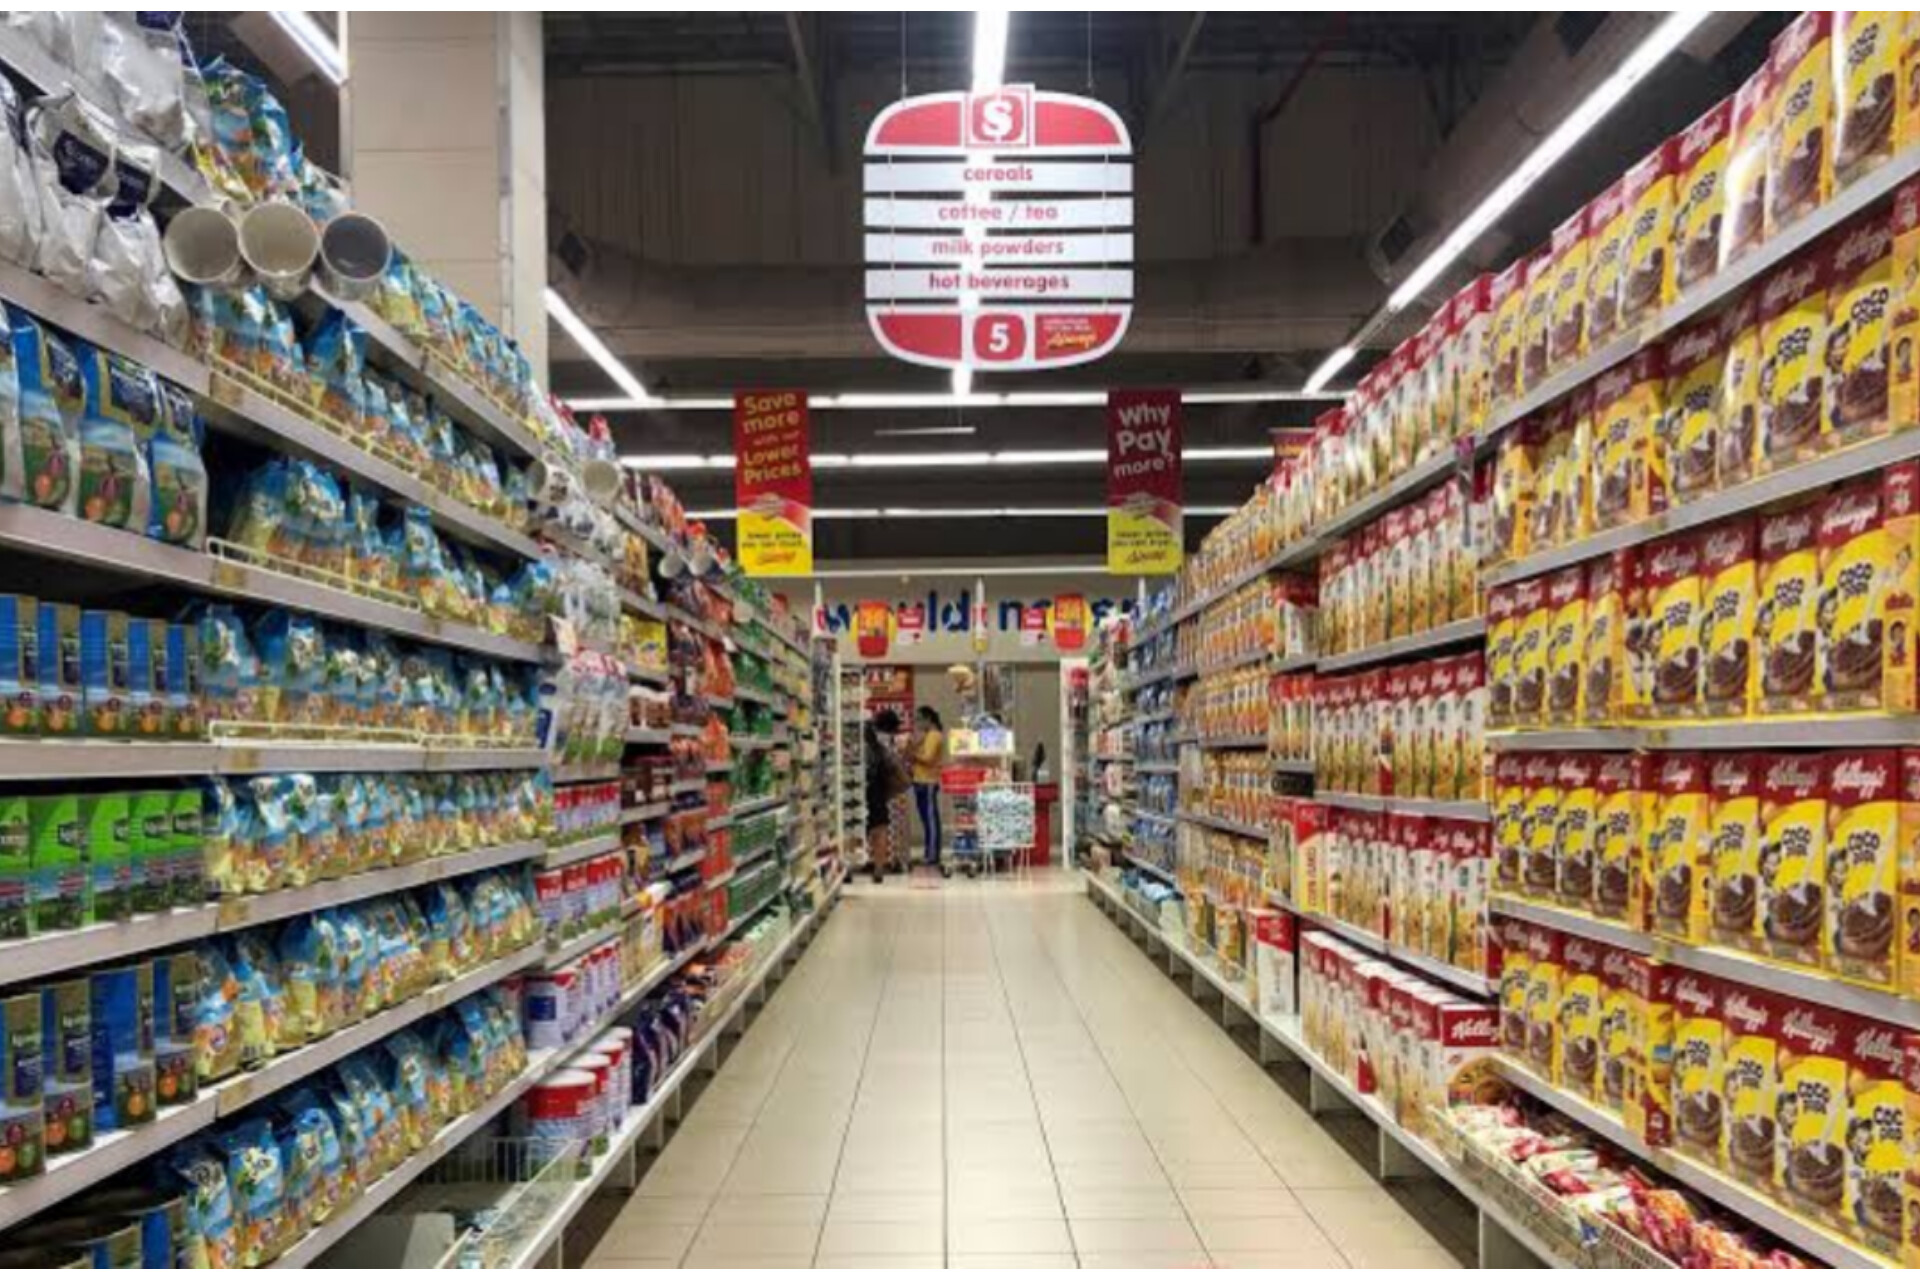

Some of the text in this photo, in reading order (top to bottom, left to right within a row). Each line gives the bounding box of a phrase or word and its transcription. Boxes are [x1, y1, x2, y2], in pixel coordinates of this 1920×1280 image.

[963, 165, 1033, 182] cereals
[938, 205, 1003, 222] coffee
[1025, 204, 1059, 220] tea
[932, 238, 1065, 258] milk powders
[929, 273, 1070, 292] hot beverages
[1850, 287, 1889, 319] COCO
[989, 322, 1011, 352] 5
[743, 392, 798, 416] Save
[1118, 402, 1172, 427] Why
[742, 410, 800, 435] more
[1115, 428, 1172, 457] Pay
[743, 444, 800, 467] Lower
[1113, 451, 1176, 480] more?
[743, 462, 802, 485] Prices
[1848, 831, 1880, 851] COCO
[1797, 1080, 1830, 1103] COCO
[1873, 1105, 1903, 1124] COC
